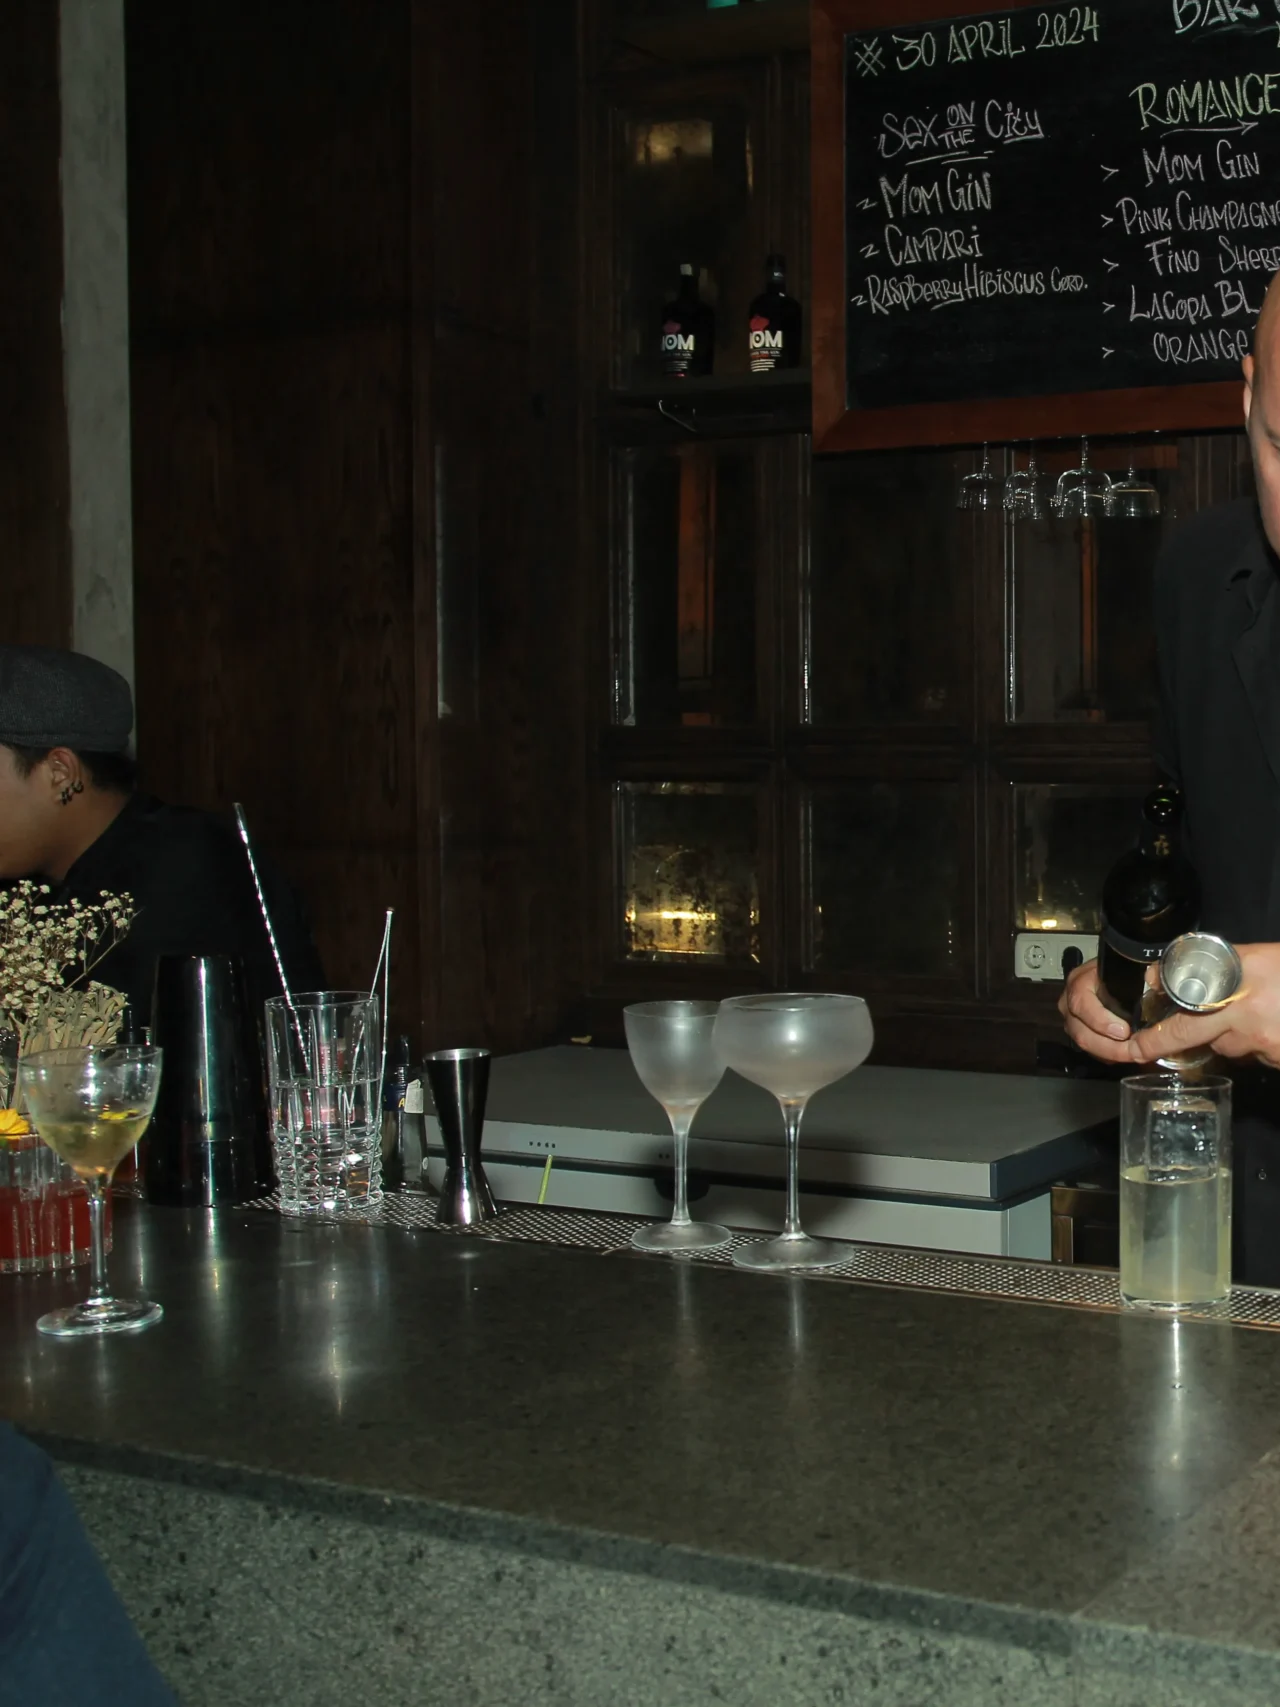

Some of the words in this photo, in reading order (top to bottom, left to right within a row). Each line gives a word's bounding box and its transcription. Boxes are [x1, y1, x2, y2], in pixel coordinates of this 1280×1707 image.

[892, 32, 937, 70] 30
[1036, 6, 1100, 49] 2024
[938, 129, 975, 149] THE
[661, 334, 695, 351] OM
